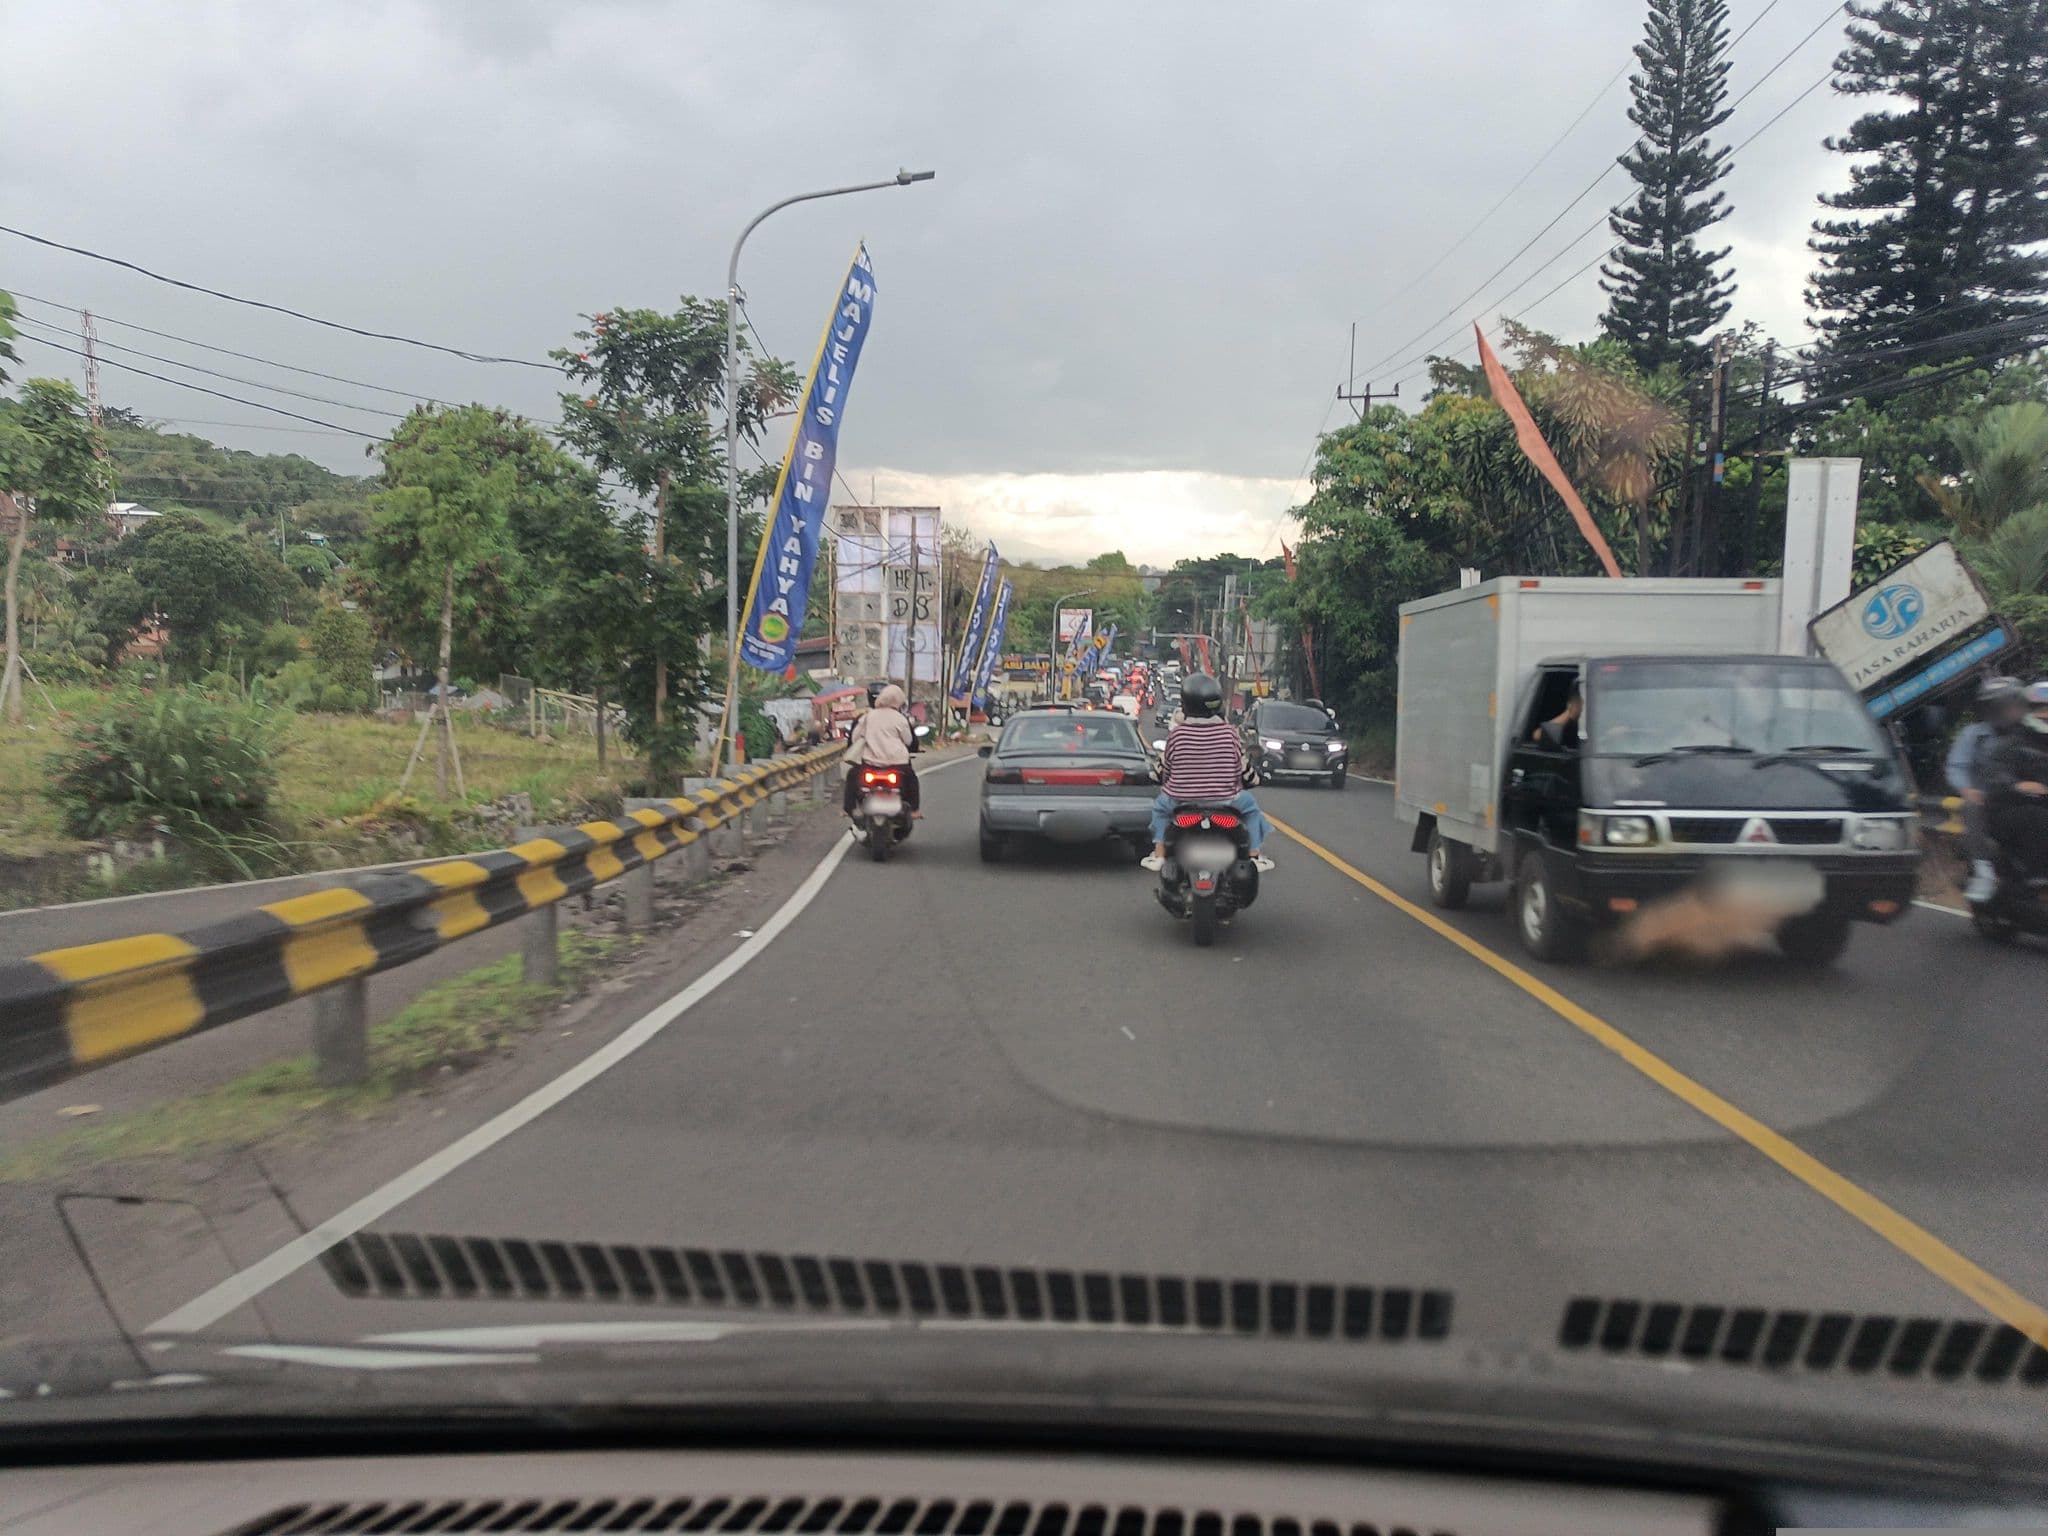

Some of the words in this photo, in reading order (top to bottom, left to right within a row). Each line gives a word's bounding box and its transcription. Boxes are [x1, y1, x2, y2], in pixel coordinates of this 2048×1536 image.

[816, 277, 872, 426] MAJELIS
[794, 440, 824, 504] BIN
[768, 514, 807, 617] YAHYA
[1854, 656, 1892, 684] JASA
